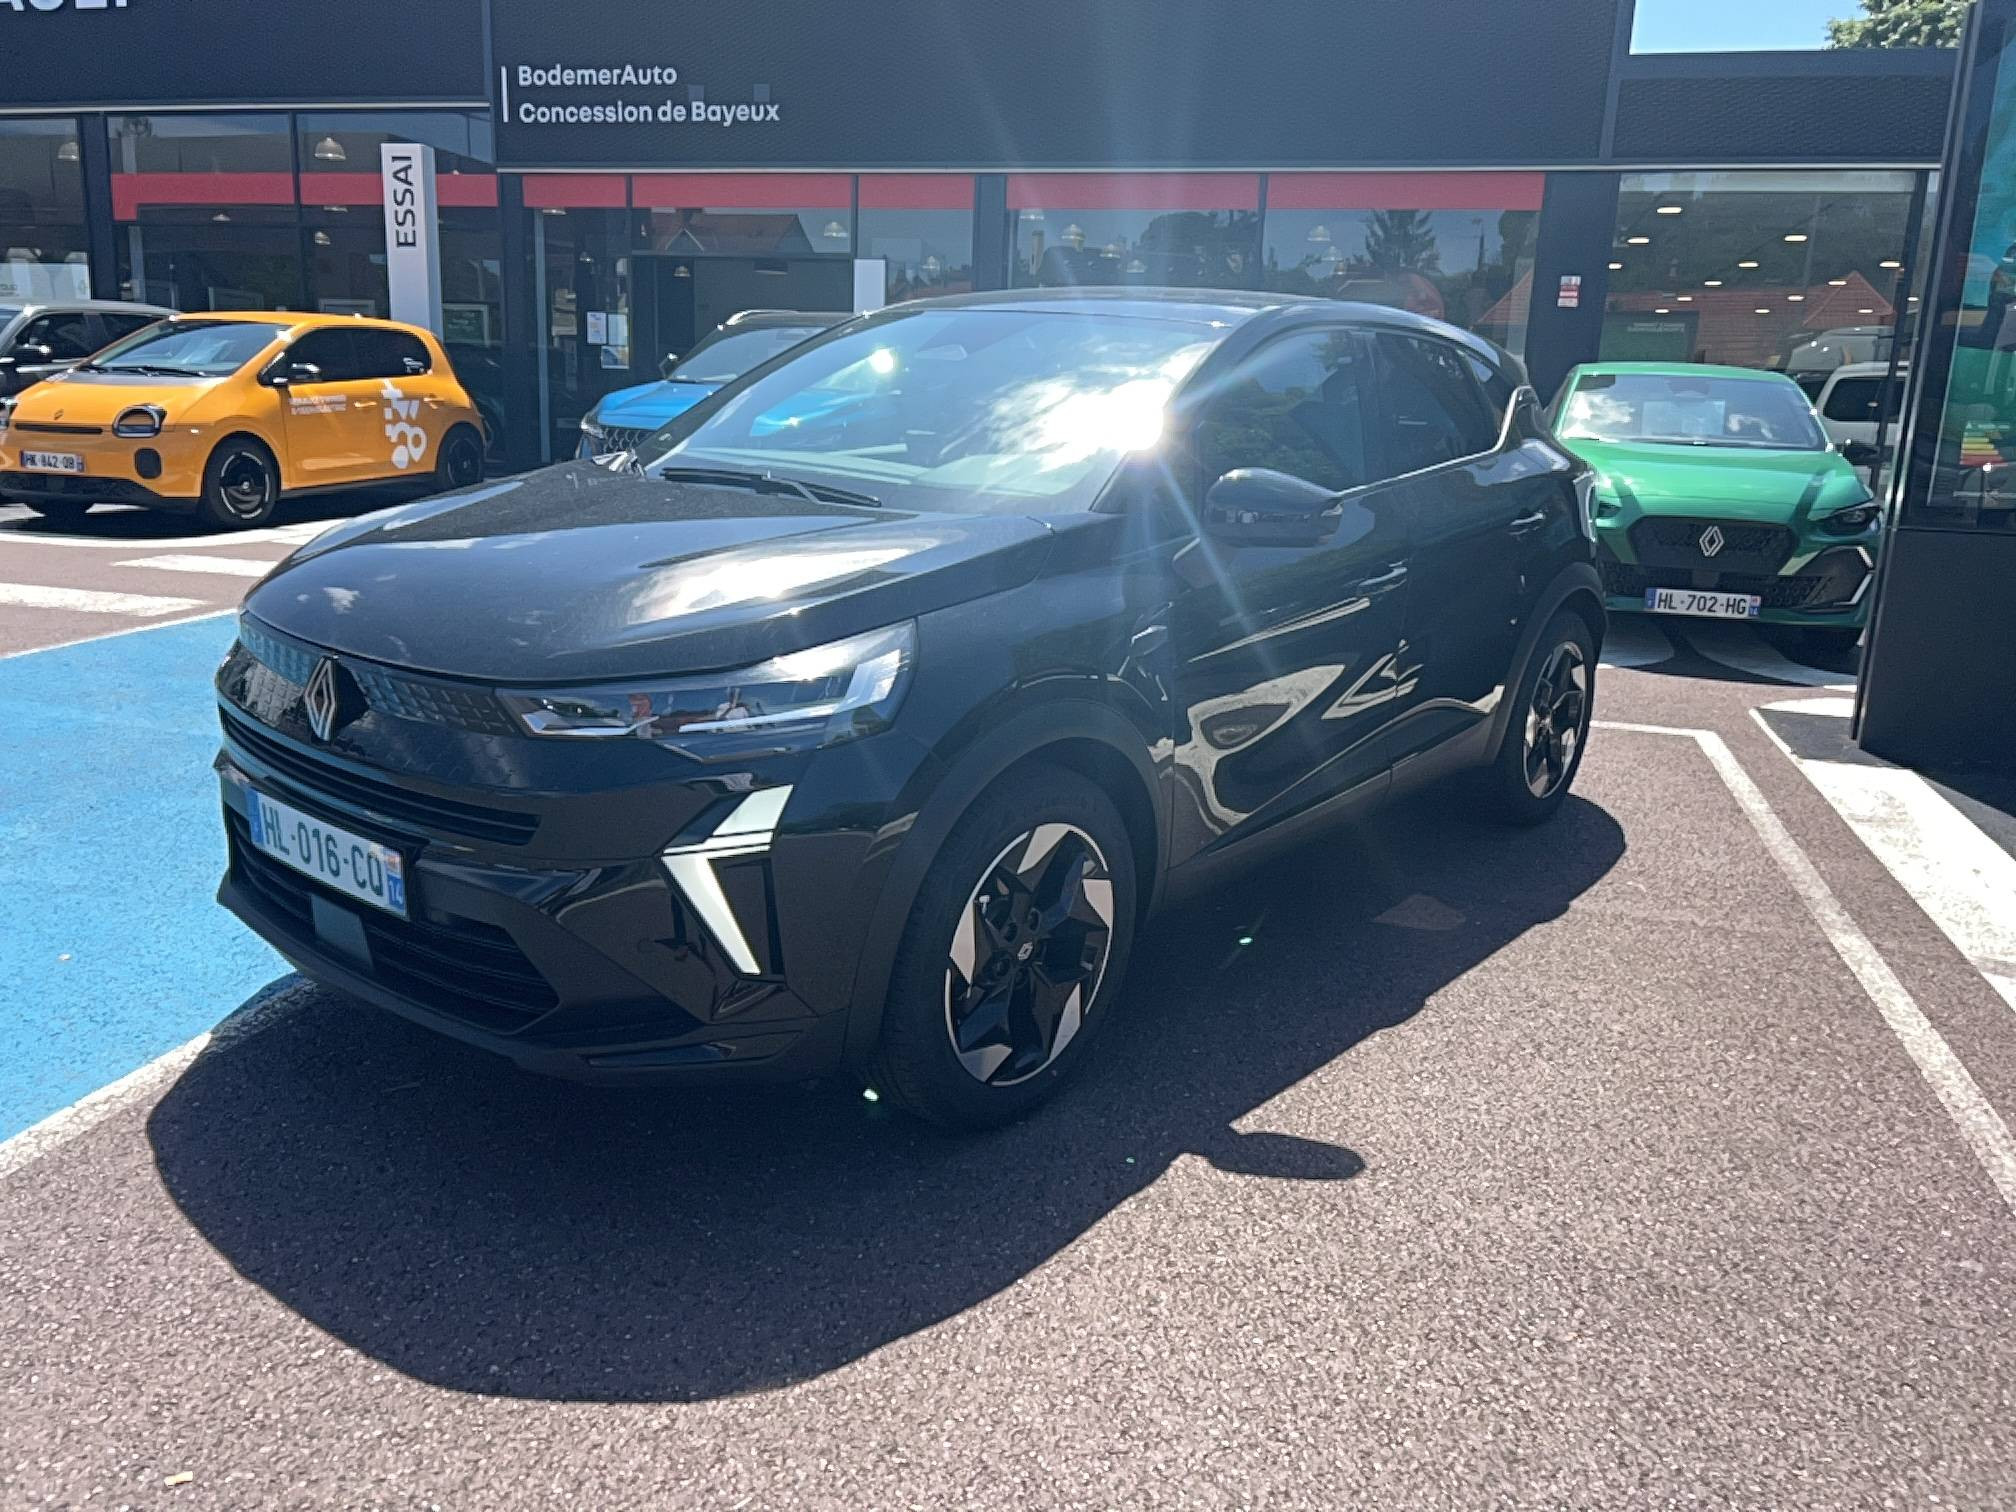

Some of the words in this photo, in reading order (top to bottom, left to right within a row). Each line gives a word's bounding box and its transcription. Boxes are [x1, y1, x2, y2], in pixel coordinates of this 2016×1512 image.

[518, 64, 677, 86] BodemerAuto
[519, 100, 652, 123] Concession
[657, 100, 687, 121] de
[691, 101, 780, 127] Bayeux
[391, 155, 416, 248] ESSAI
[1658, 592, 1747, 615] HL-702-HG
